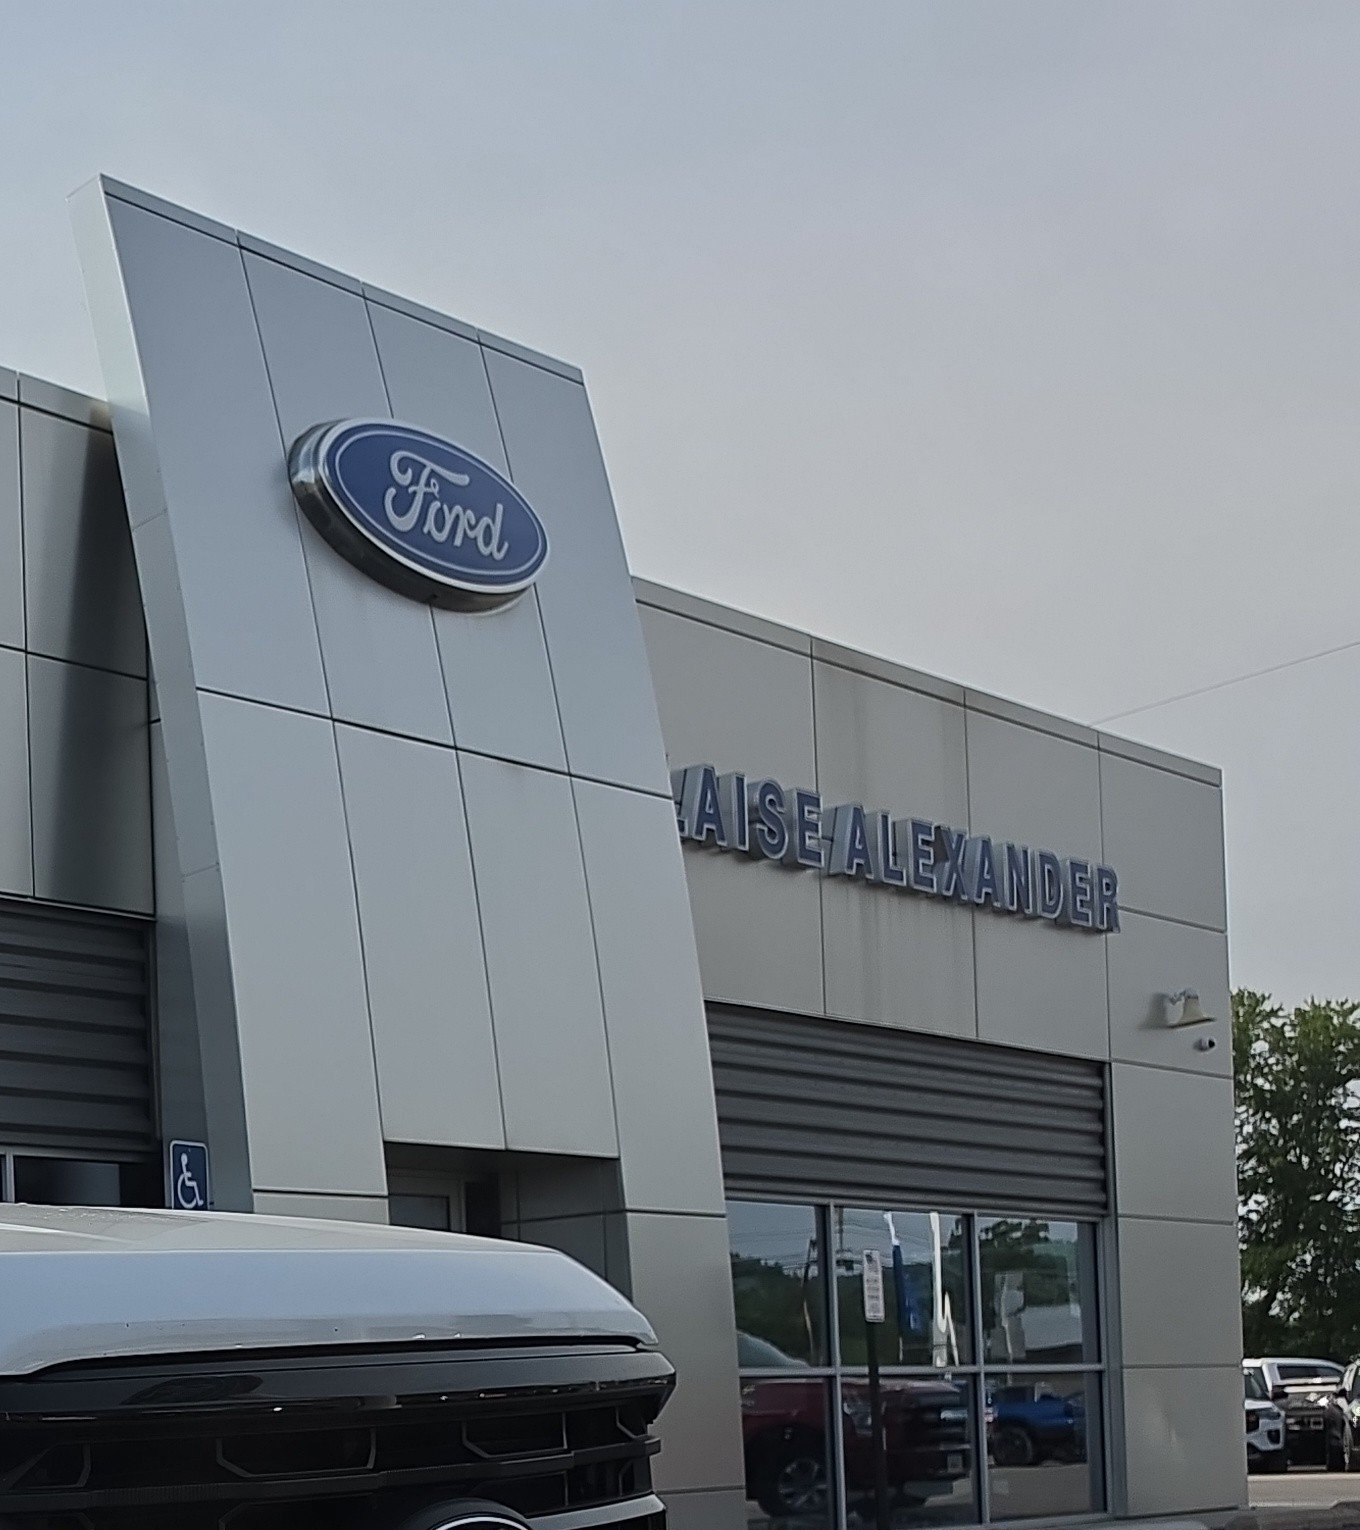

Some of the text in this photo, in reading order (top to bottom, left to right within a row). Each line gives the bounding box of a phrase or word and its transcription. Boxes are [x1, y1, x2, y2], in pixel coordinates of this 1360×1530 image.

[384, 450, 509, 561] Ford
[673, 763, 1121, 934] AISE ALEXANDER
